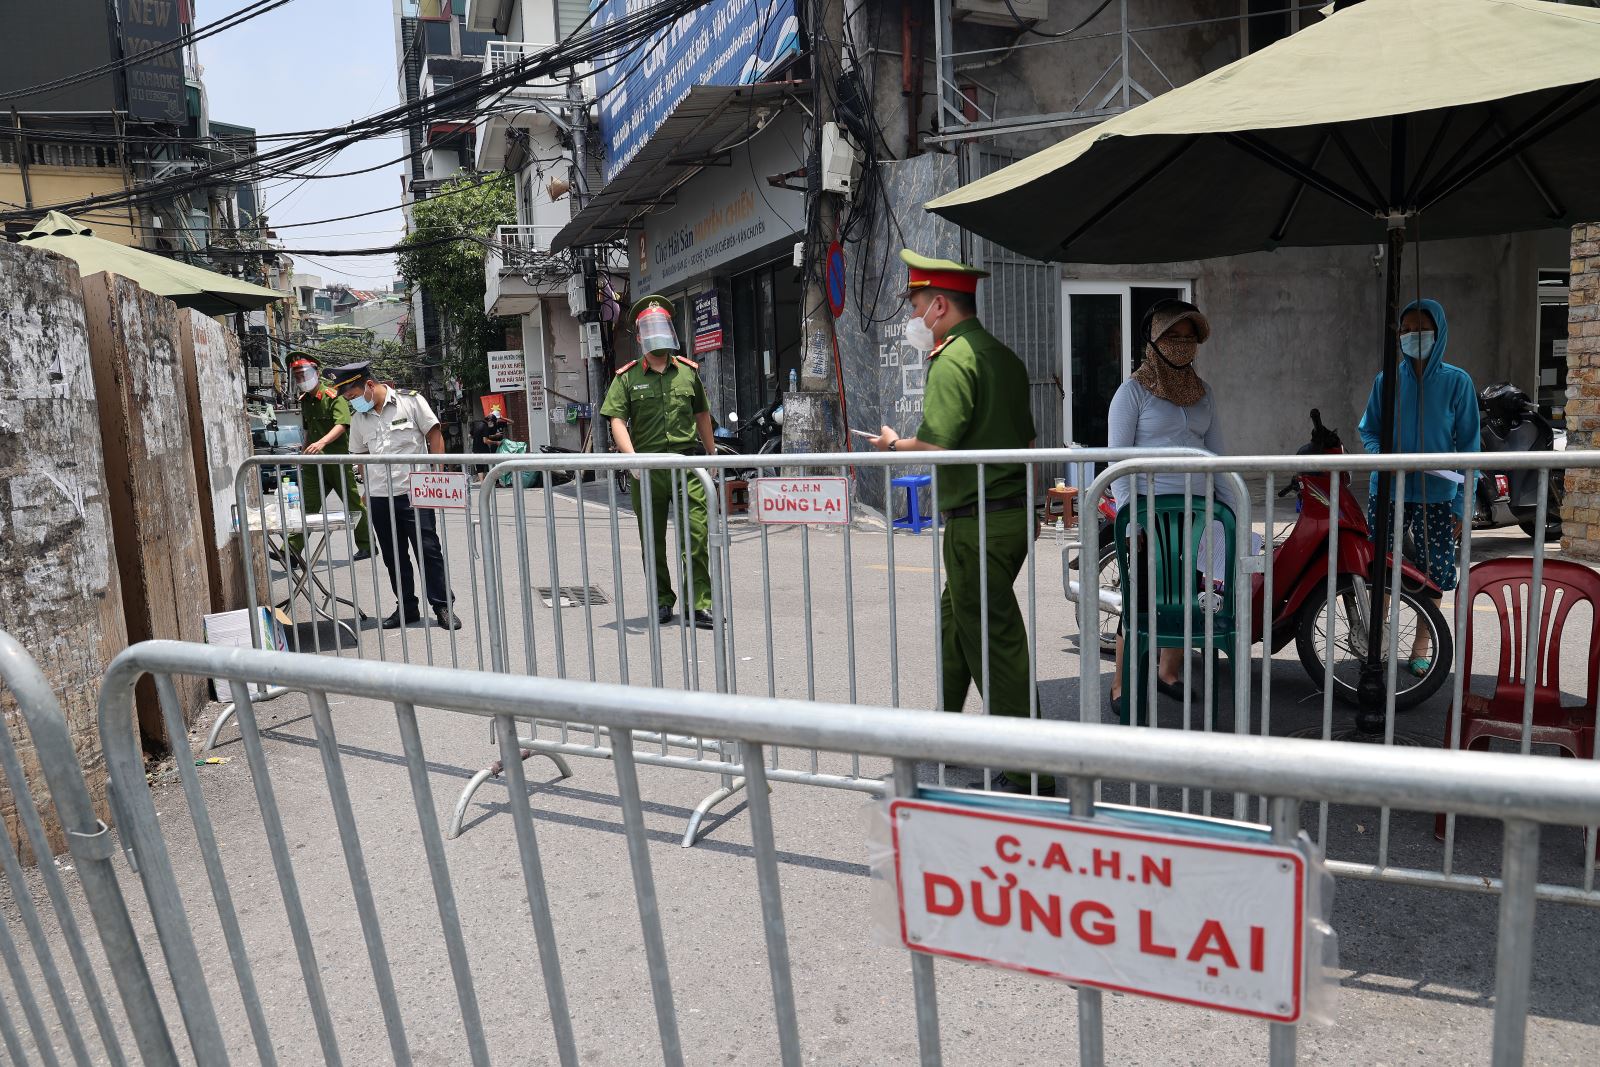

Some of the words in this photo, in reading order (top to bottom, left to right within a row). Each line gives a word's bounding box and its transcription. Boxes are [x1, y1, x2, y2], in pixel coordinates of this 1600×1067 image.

[127, 0, 170, 27] NEW
[127, 37, 178, 68] YORK
[132, 70, 180, 89] KARAOKE
[655, 241, 669, 266] Chợ
[668, 231, 680, 253] Hải
[680, 224, 694, 251] Sản
[424, 476, 450, 484] C.A.H.N
[781, 484, 821, 493] C.A.H.N
[414, 484, 443, 499] DỪNG
[444, 488, 463, 502] LẠI
[763, 494, 809, 512] DỪNG
[813, 498, 841, 515] LẠI
[994, 834, 1173, 888] C.A.H.N
[922, 865, 1117, 946] DỪNG
[1138, 908, 1265, 977] LẠI
